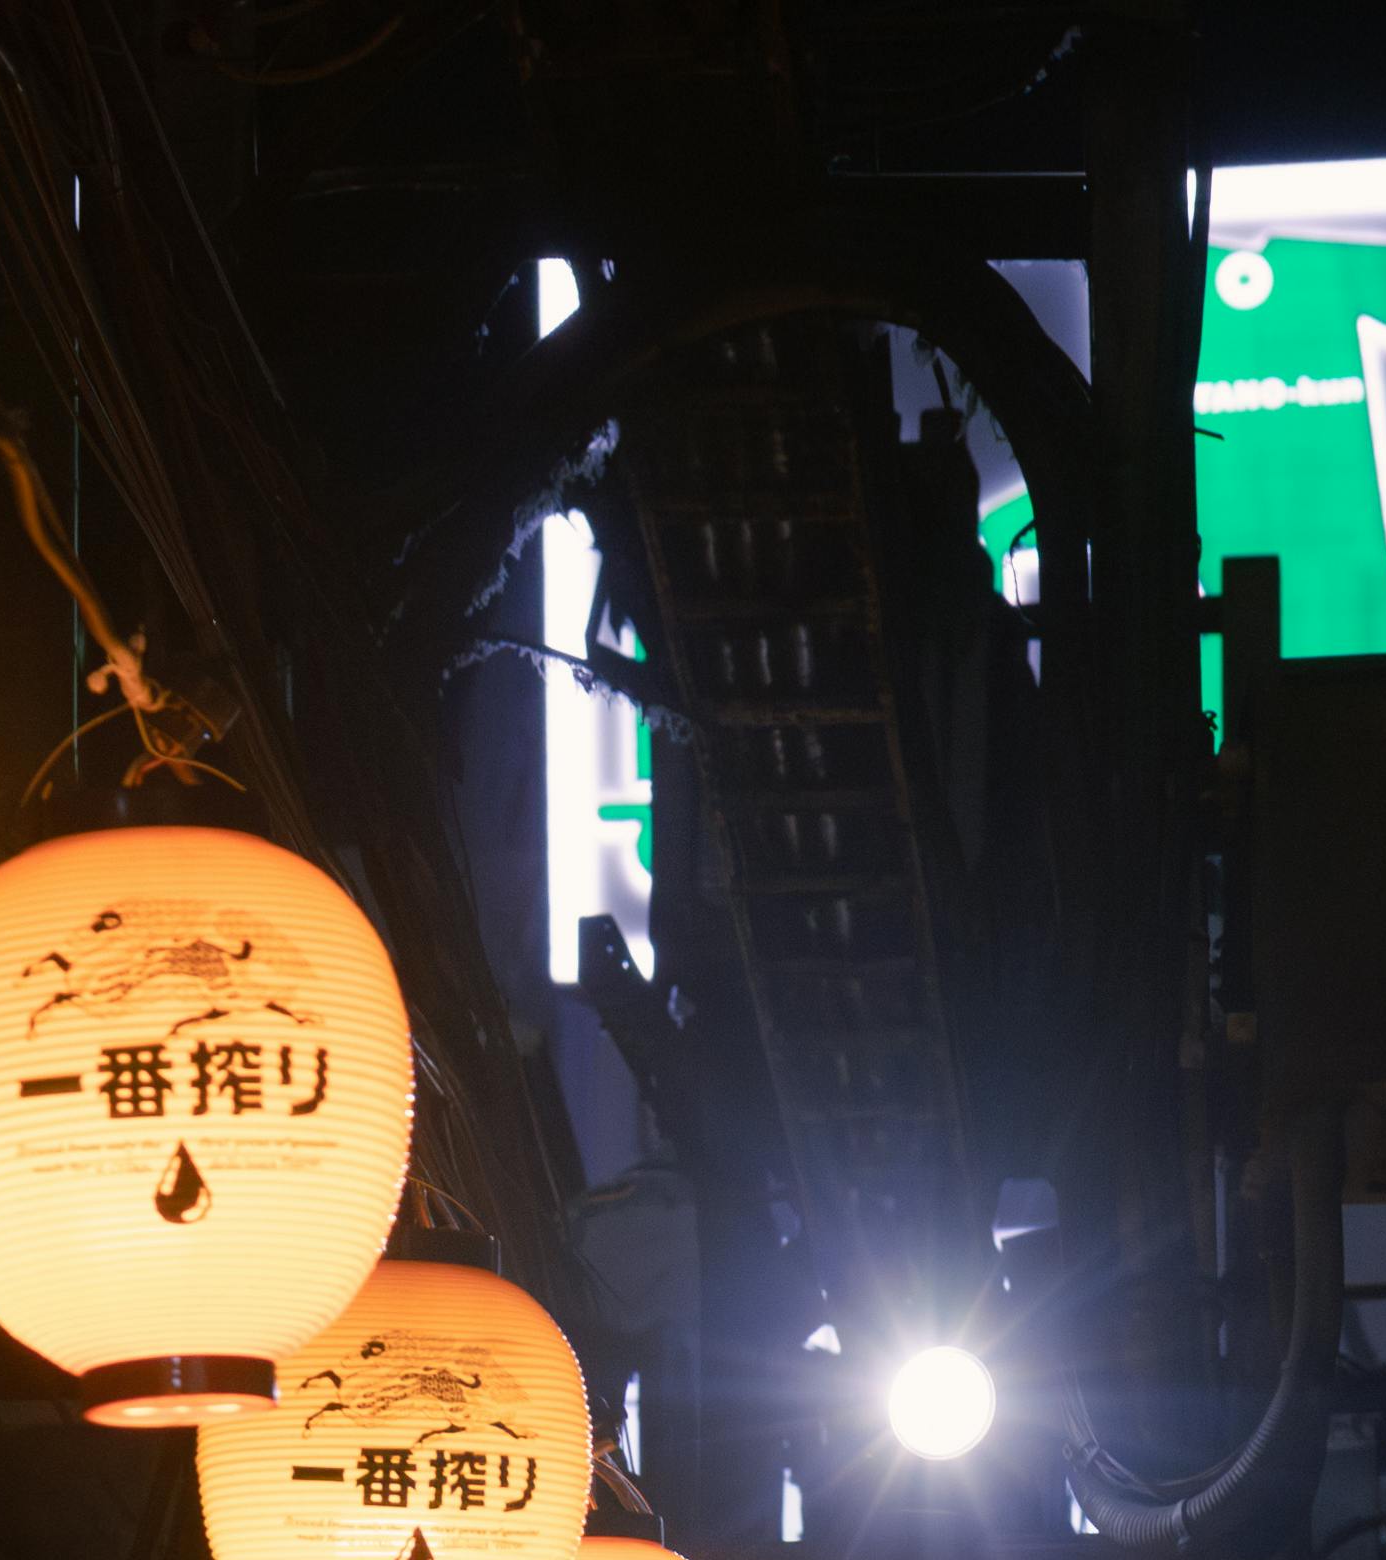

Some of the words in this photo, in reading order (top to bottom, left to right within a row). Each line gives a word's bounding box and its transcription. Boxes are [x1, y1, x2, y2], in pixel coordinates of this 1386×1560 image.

[19, 1041, 328, 1118] 一番搾り
[292, 1447, 536, 1512] 一番搾り
